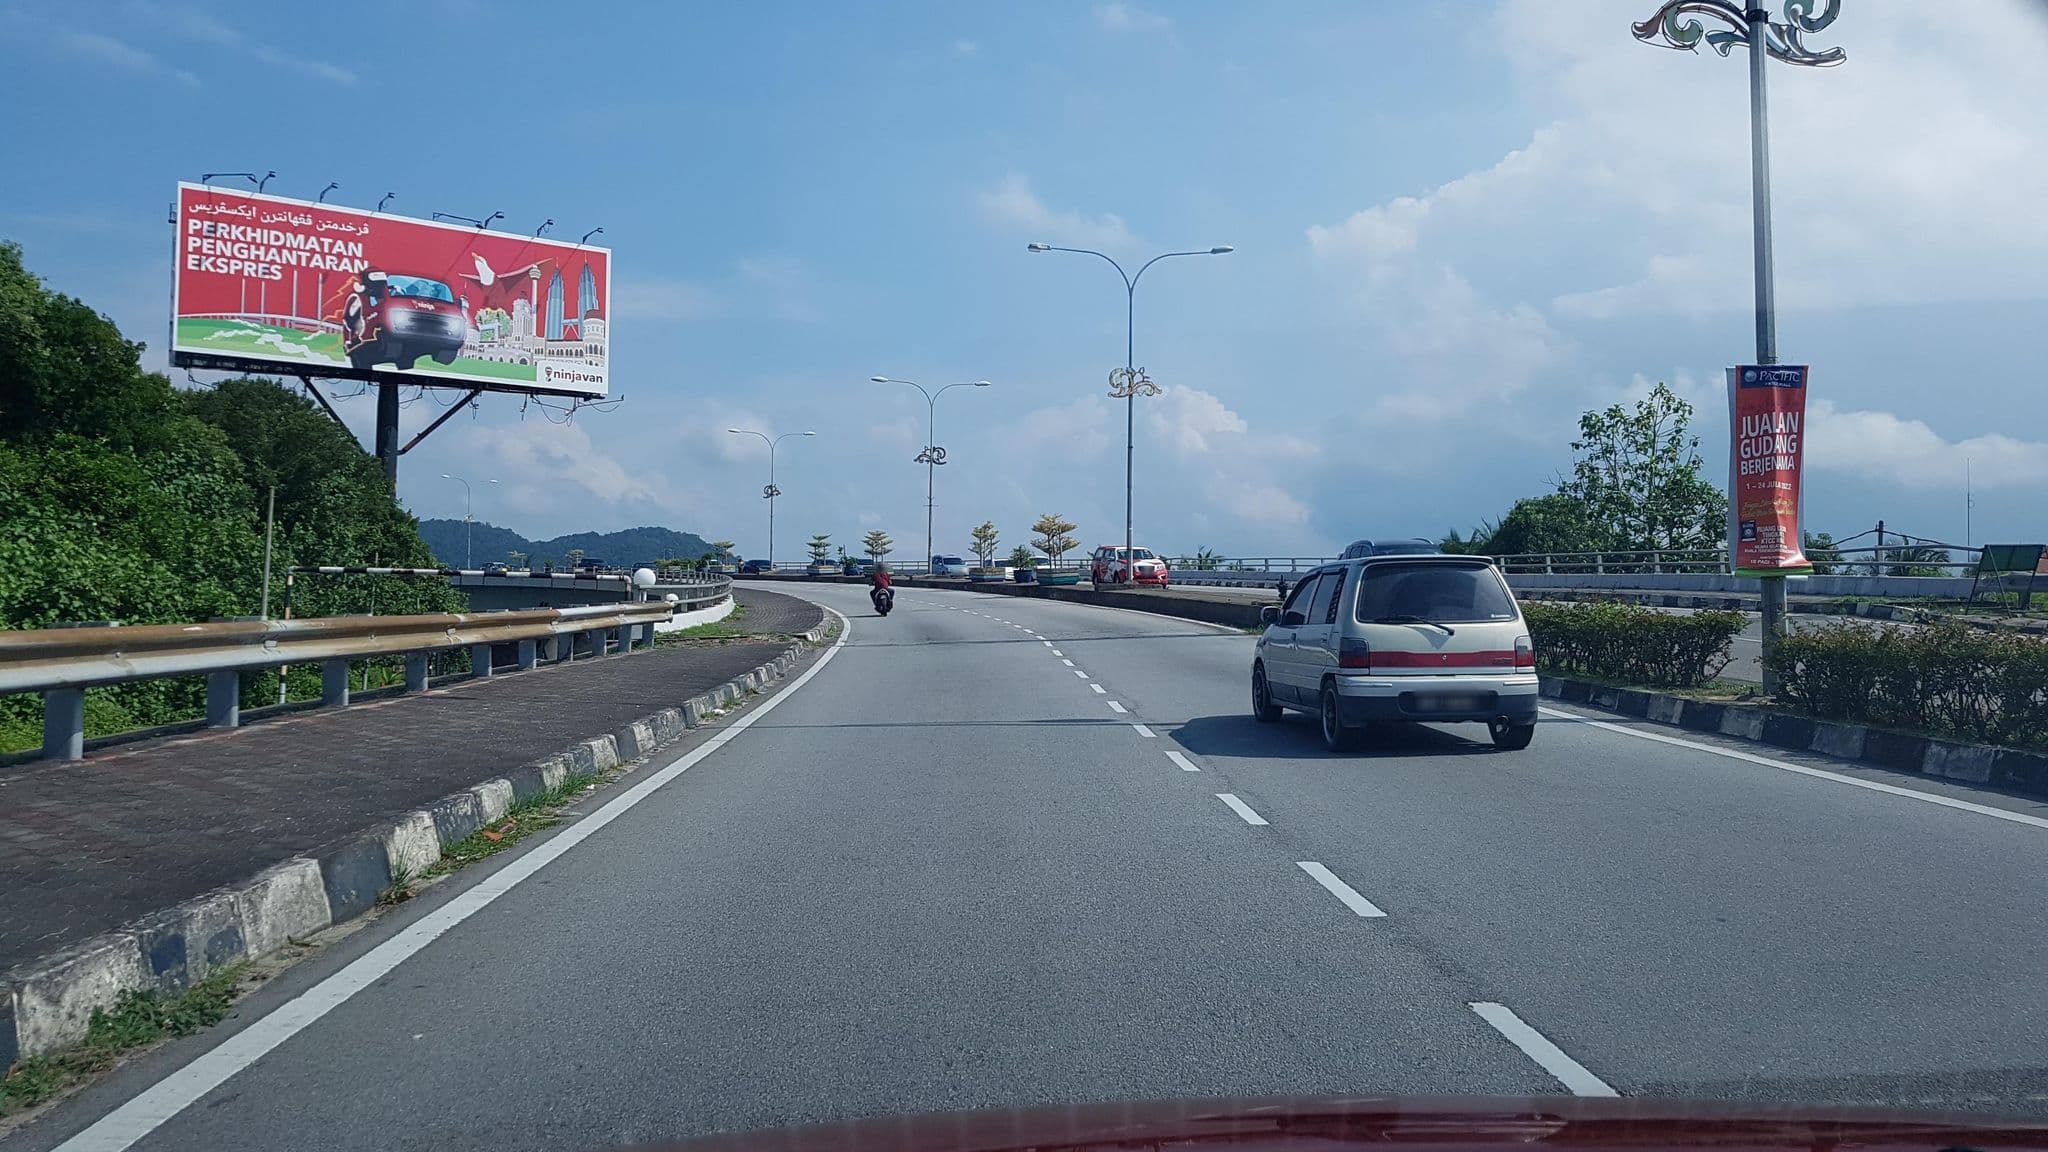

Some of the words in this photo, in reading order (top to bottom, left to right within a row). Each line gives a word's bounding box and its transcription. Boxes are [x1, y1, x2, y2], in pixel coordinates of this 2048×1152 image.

[187, 218, 363, 258] PERKHIDMATAN
[186, 252, 283, 280] EKSPRES
[187, 235, 369, 274] PENGHANTARAN
[553, 368, 603, 383] ninjavan
[1759, 370, 1800, 382] PACIFIC
[1740, 411, 1799, 439] JUALAN
[1740, 434, 1798, 459] GUDANG
[1740, 455, 1796, 476] BERJENAMA
